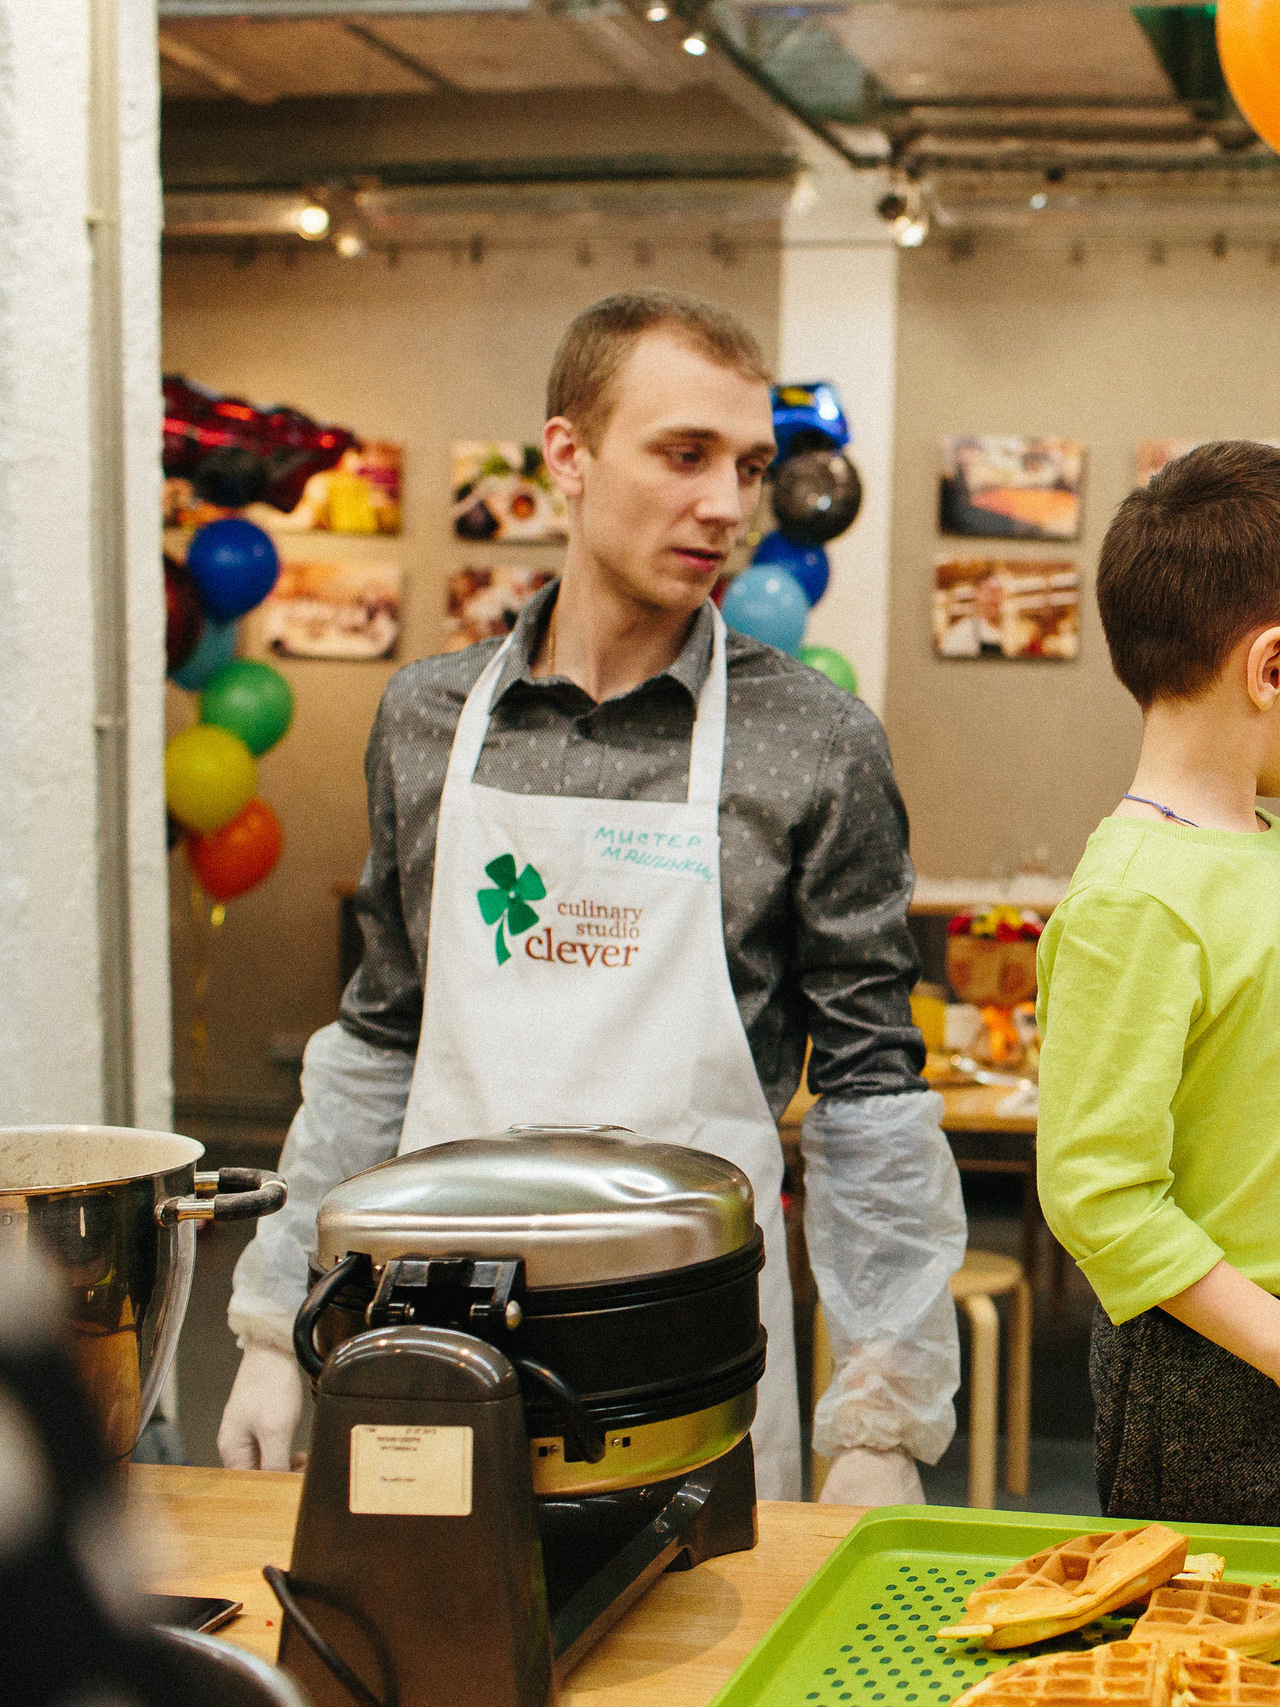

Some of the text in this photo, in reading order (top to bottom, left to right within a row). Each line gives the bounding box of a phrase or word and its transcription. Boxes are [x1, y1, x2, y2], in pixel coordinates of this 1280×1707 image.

[594, 826, 701, 849] МИСТЕР
[557, 900, 643, 924] culinary
[576, 922, 641, 939] studio
[525, 927, 639, 967] clever
